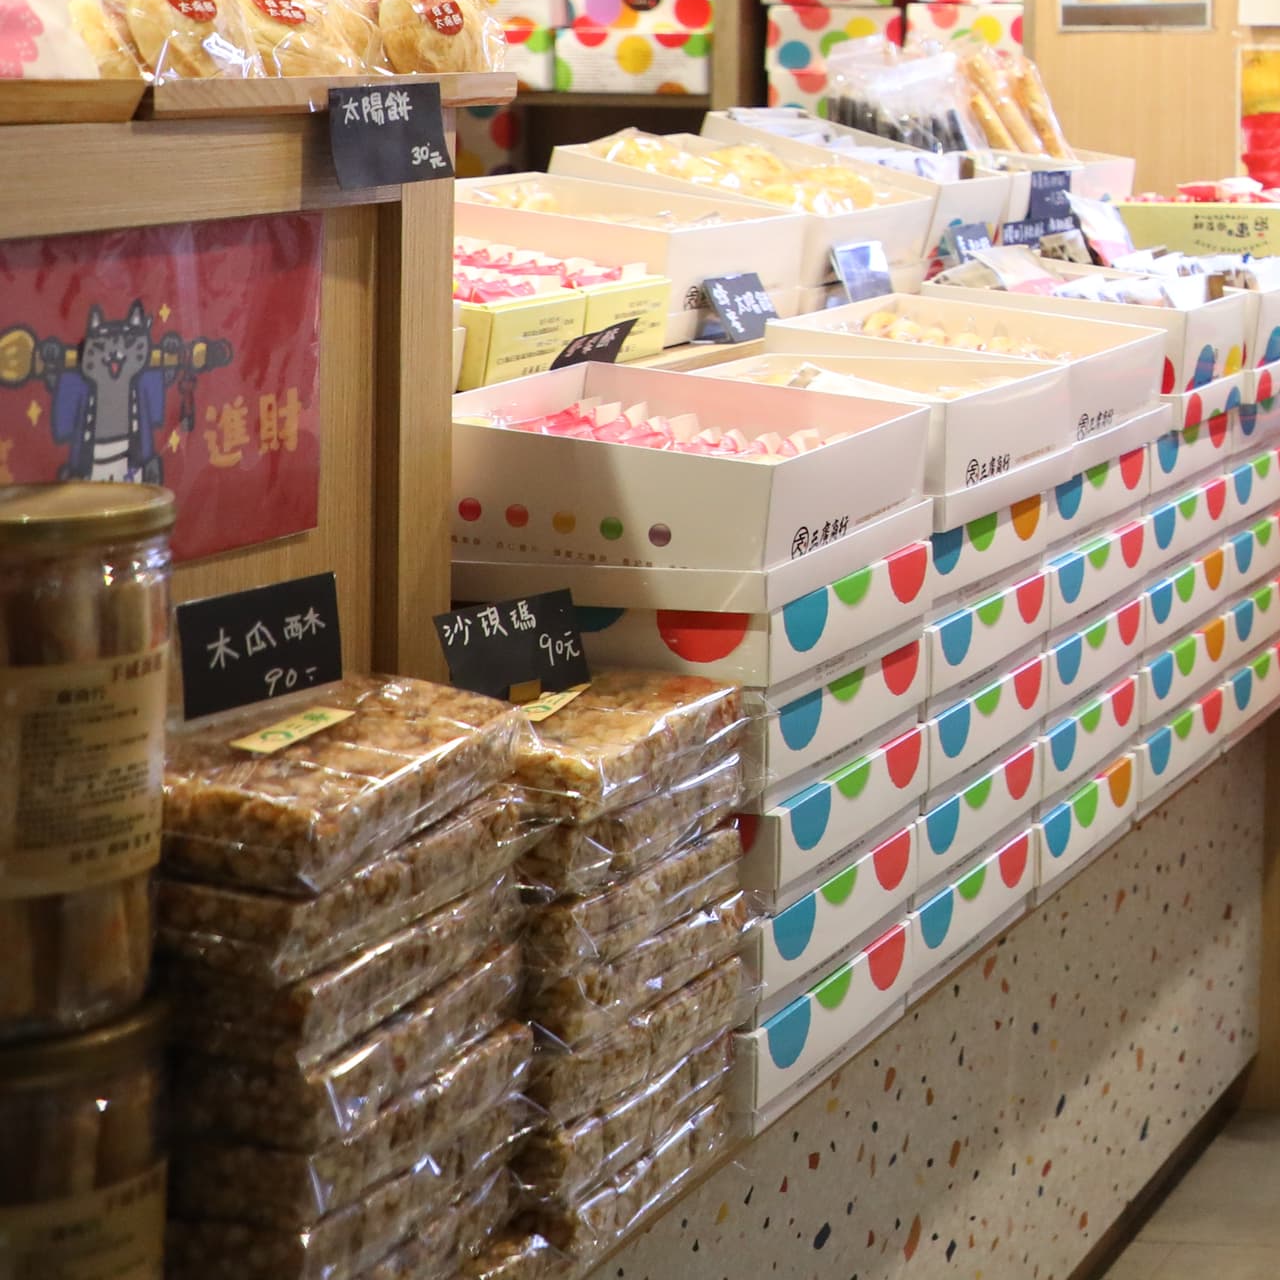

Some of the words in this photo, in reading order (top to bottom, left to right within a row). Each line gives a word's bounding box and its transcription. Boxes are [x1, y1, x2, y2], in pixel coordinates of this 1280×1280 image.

[342, 91, 413, 125] 太陽餅
[203, 386, 301, 467] 進財
[808, 515, 849, 552] 三廣商行
[539, 630, 581, 667] 90元
